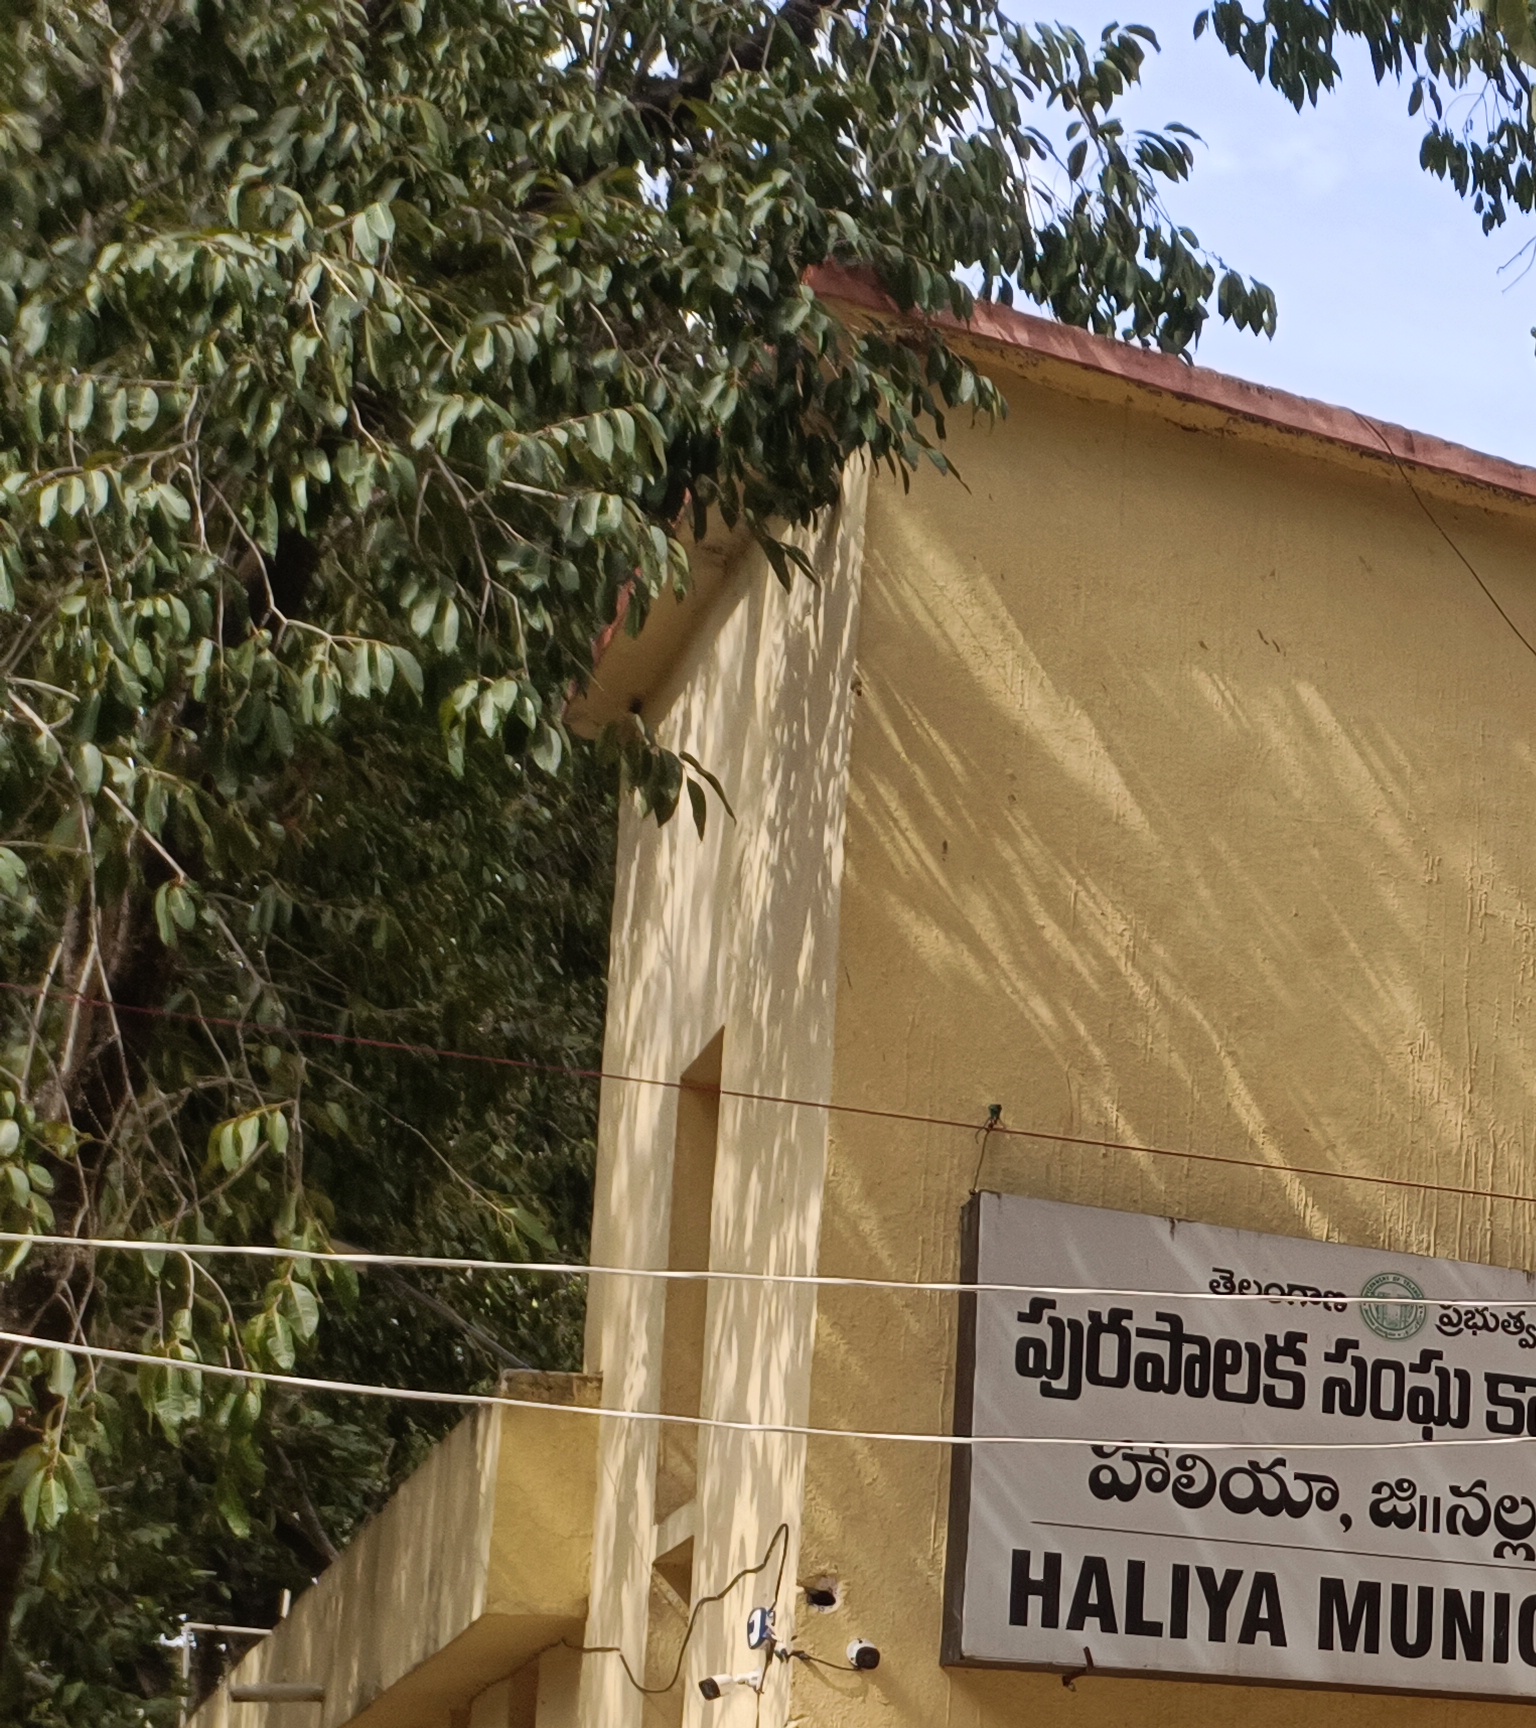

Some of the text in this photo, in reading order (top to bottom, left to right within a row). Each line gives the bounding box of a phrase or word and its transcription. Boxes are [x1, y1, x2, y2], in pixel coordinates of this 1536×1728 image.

[1014, 1296, 1309, 1410] పురపాలక
[1321, 1337, 1471, 1441] సంఘ
[1008, 1548, 1289, 1648] HALIYA
